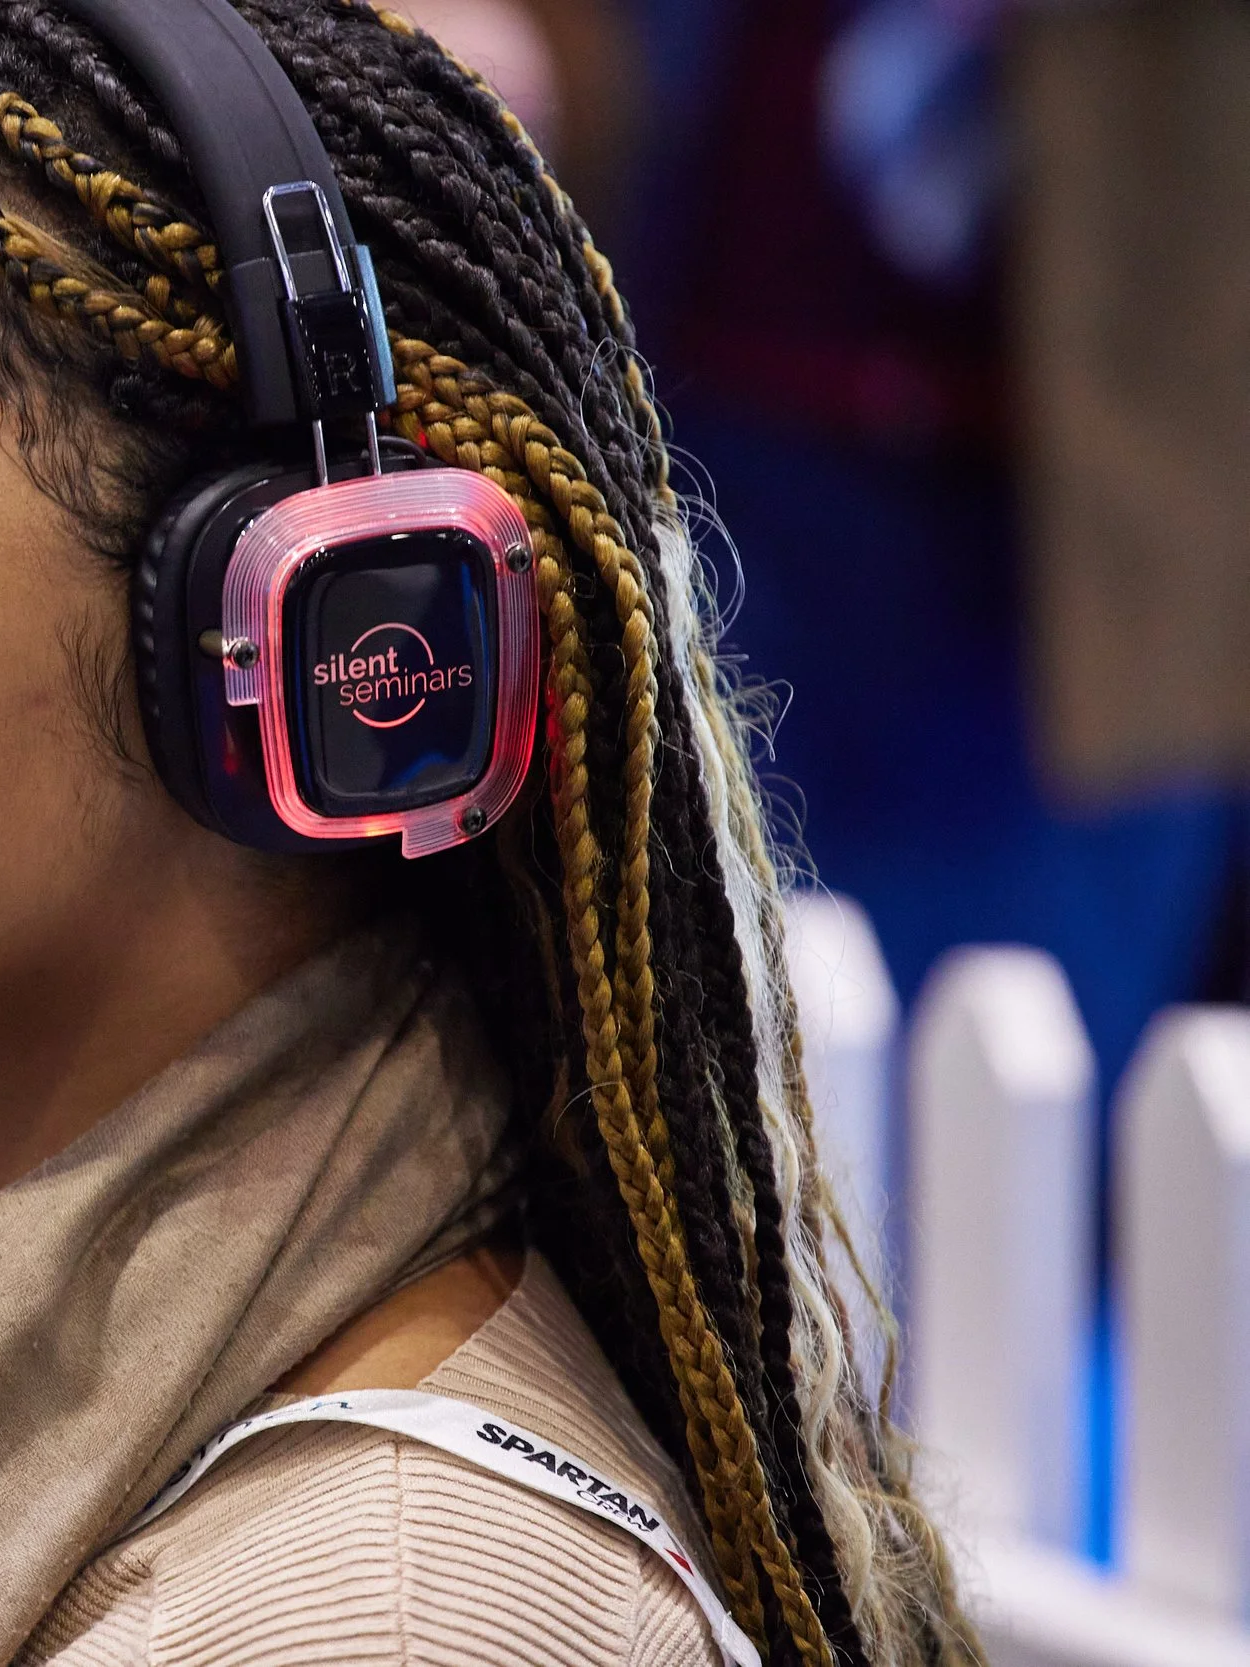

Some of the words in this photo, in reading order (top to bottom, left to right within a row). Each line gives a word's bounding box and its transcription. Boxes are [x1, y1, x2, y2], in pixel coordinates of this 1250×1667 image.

[313, 646, 399, 685] silent
[339, 664, 473, 706] seminars
[476, 1422, 660, 1532] SPARTAN
[576, 1490, 651, 1532] CREW
